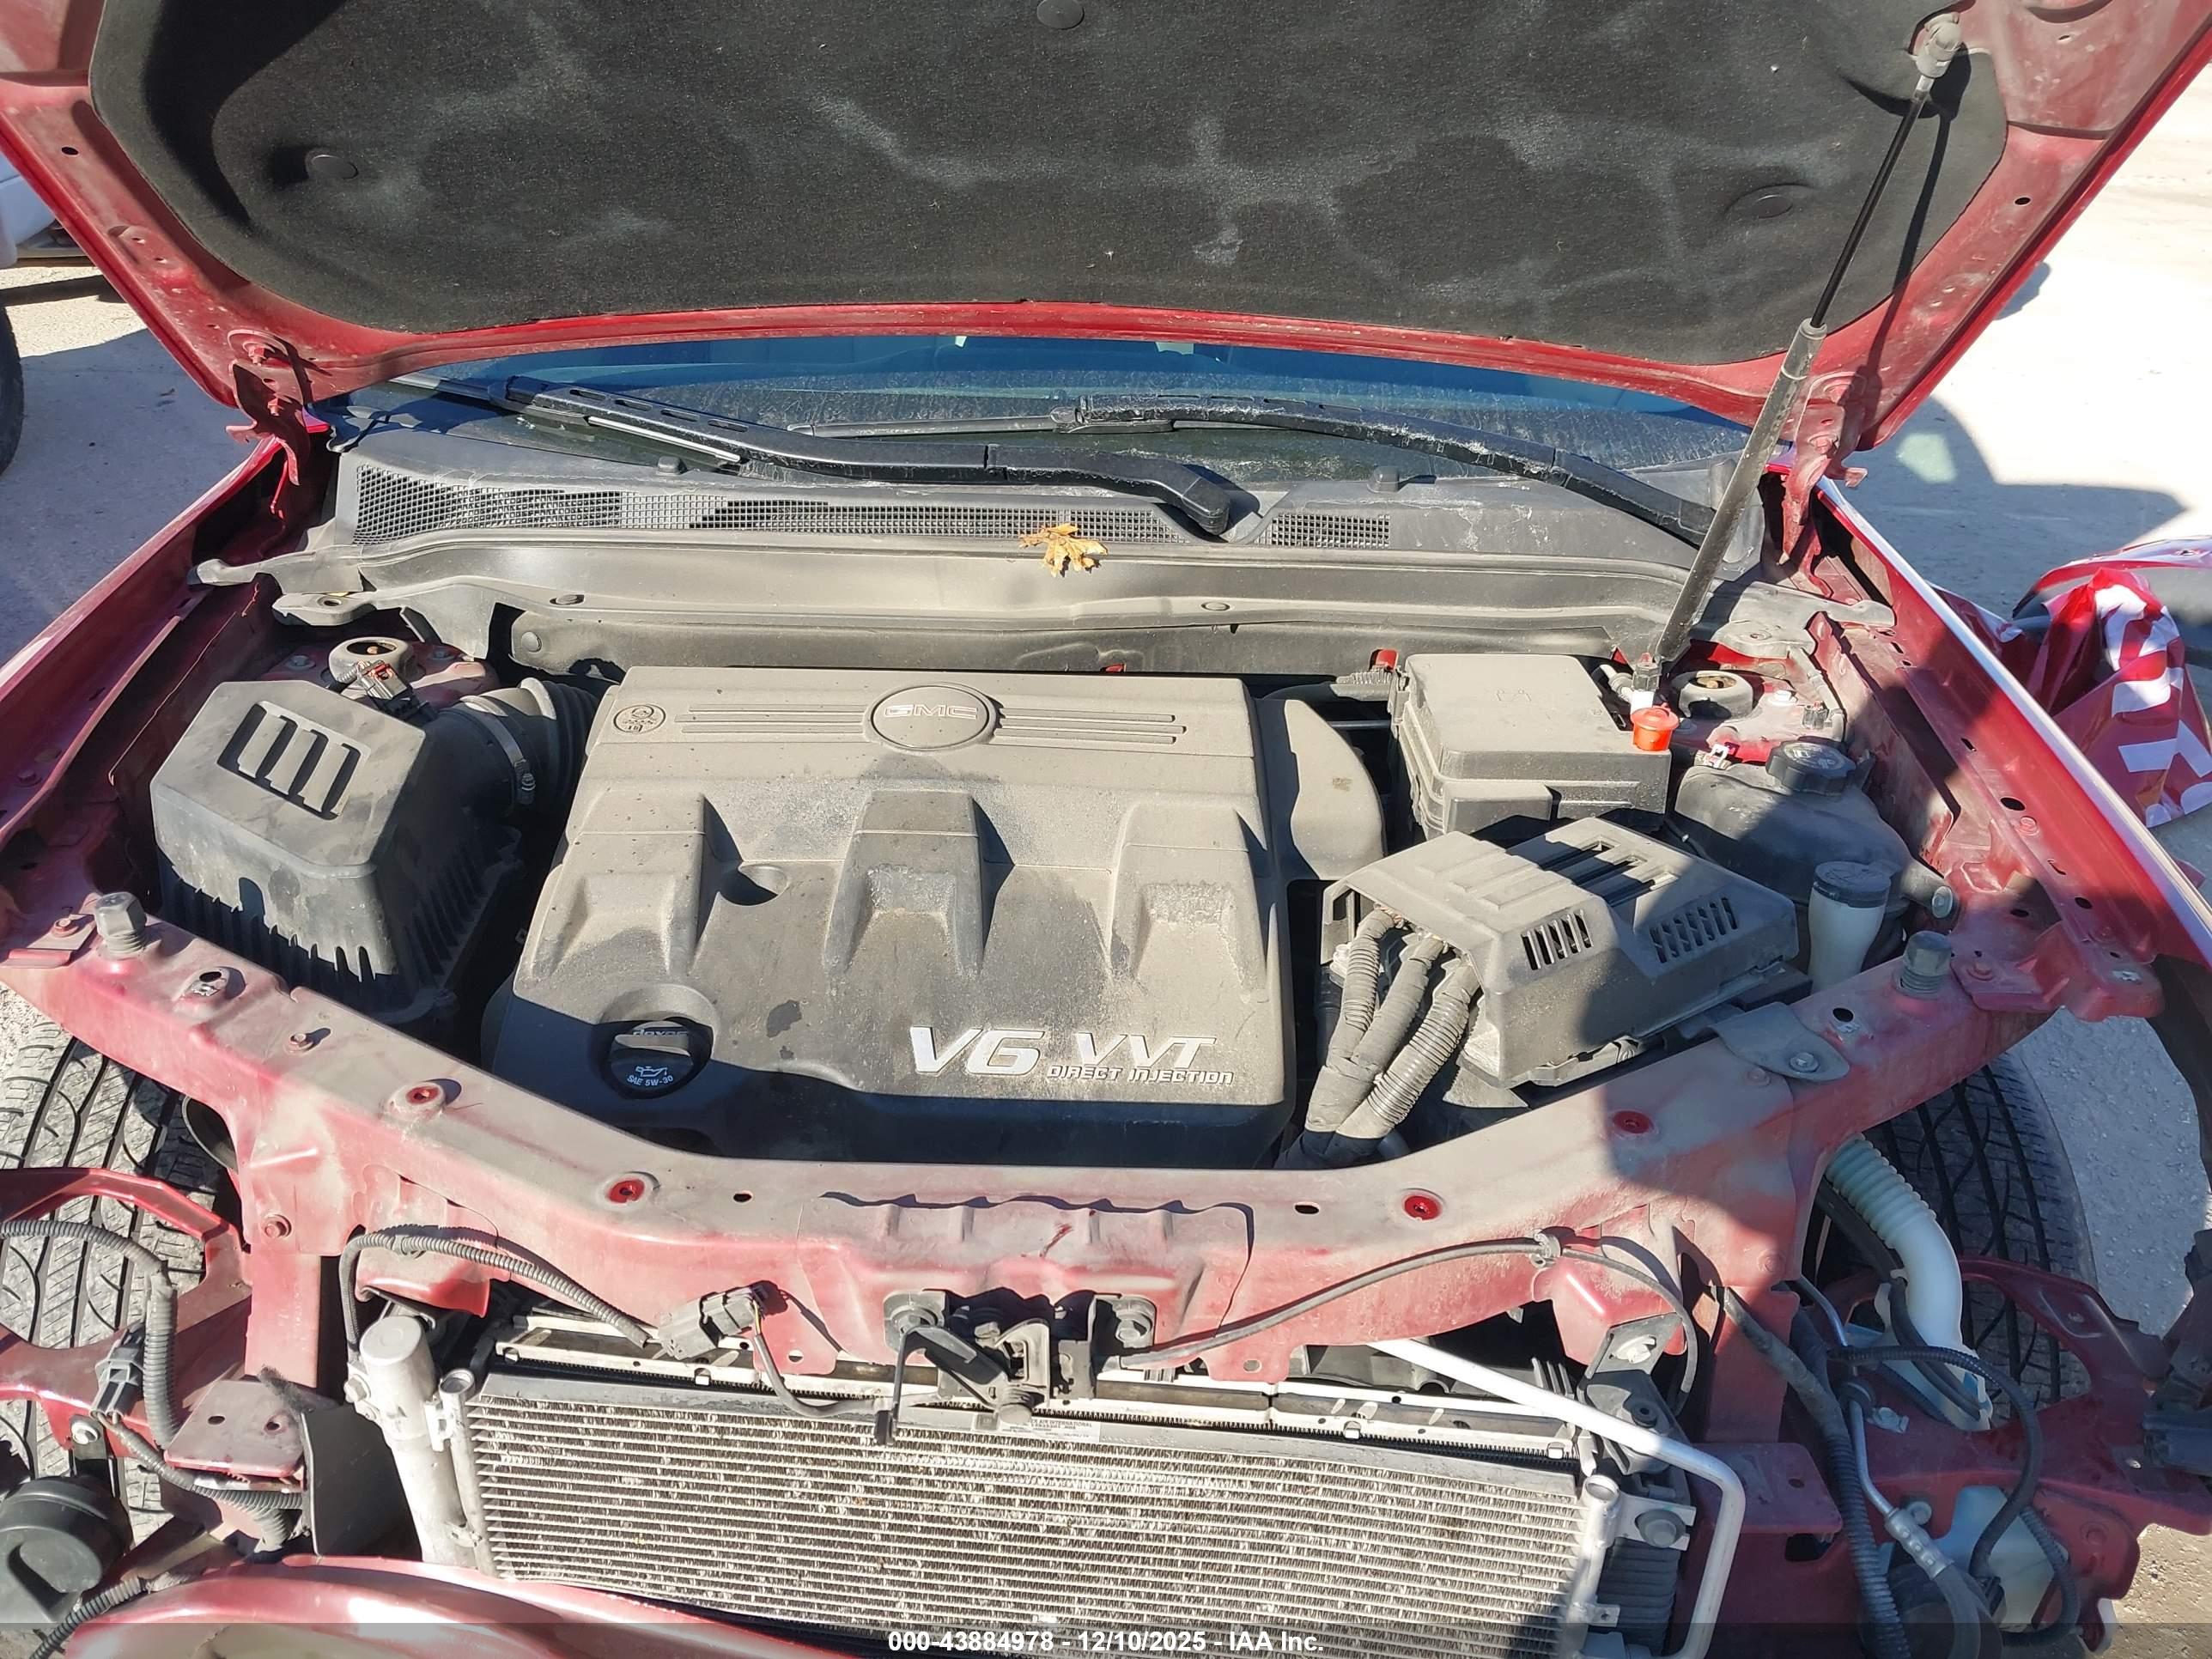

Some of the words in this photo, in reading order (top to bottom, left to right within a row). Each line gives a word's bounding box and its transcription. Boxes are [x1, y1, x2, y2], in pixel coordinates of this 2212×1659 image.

[884, 704, 978, 720] GMC
[910, 1026, 1046, 1075] V6
[1076, 1032, 1217, 1068] VVT
[627, 1074, 643, 1085] SAE
[645, 1074, 674, 1086] 5W-30
[1047, 1065, 1121, 1081] DIRECT
[1129, 1068, 1235, 1085] INJECTION
